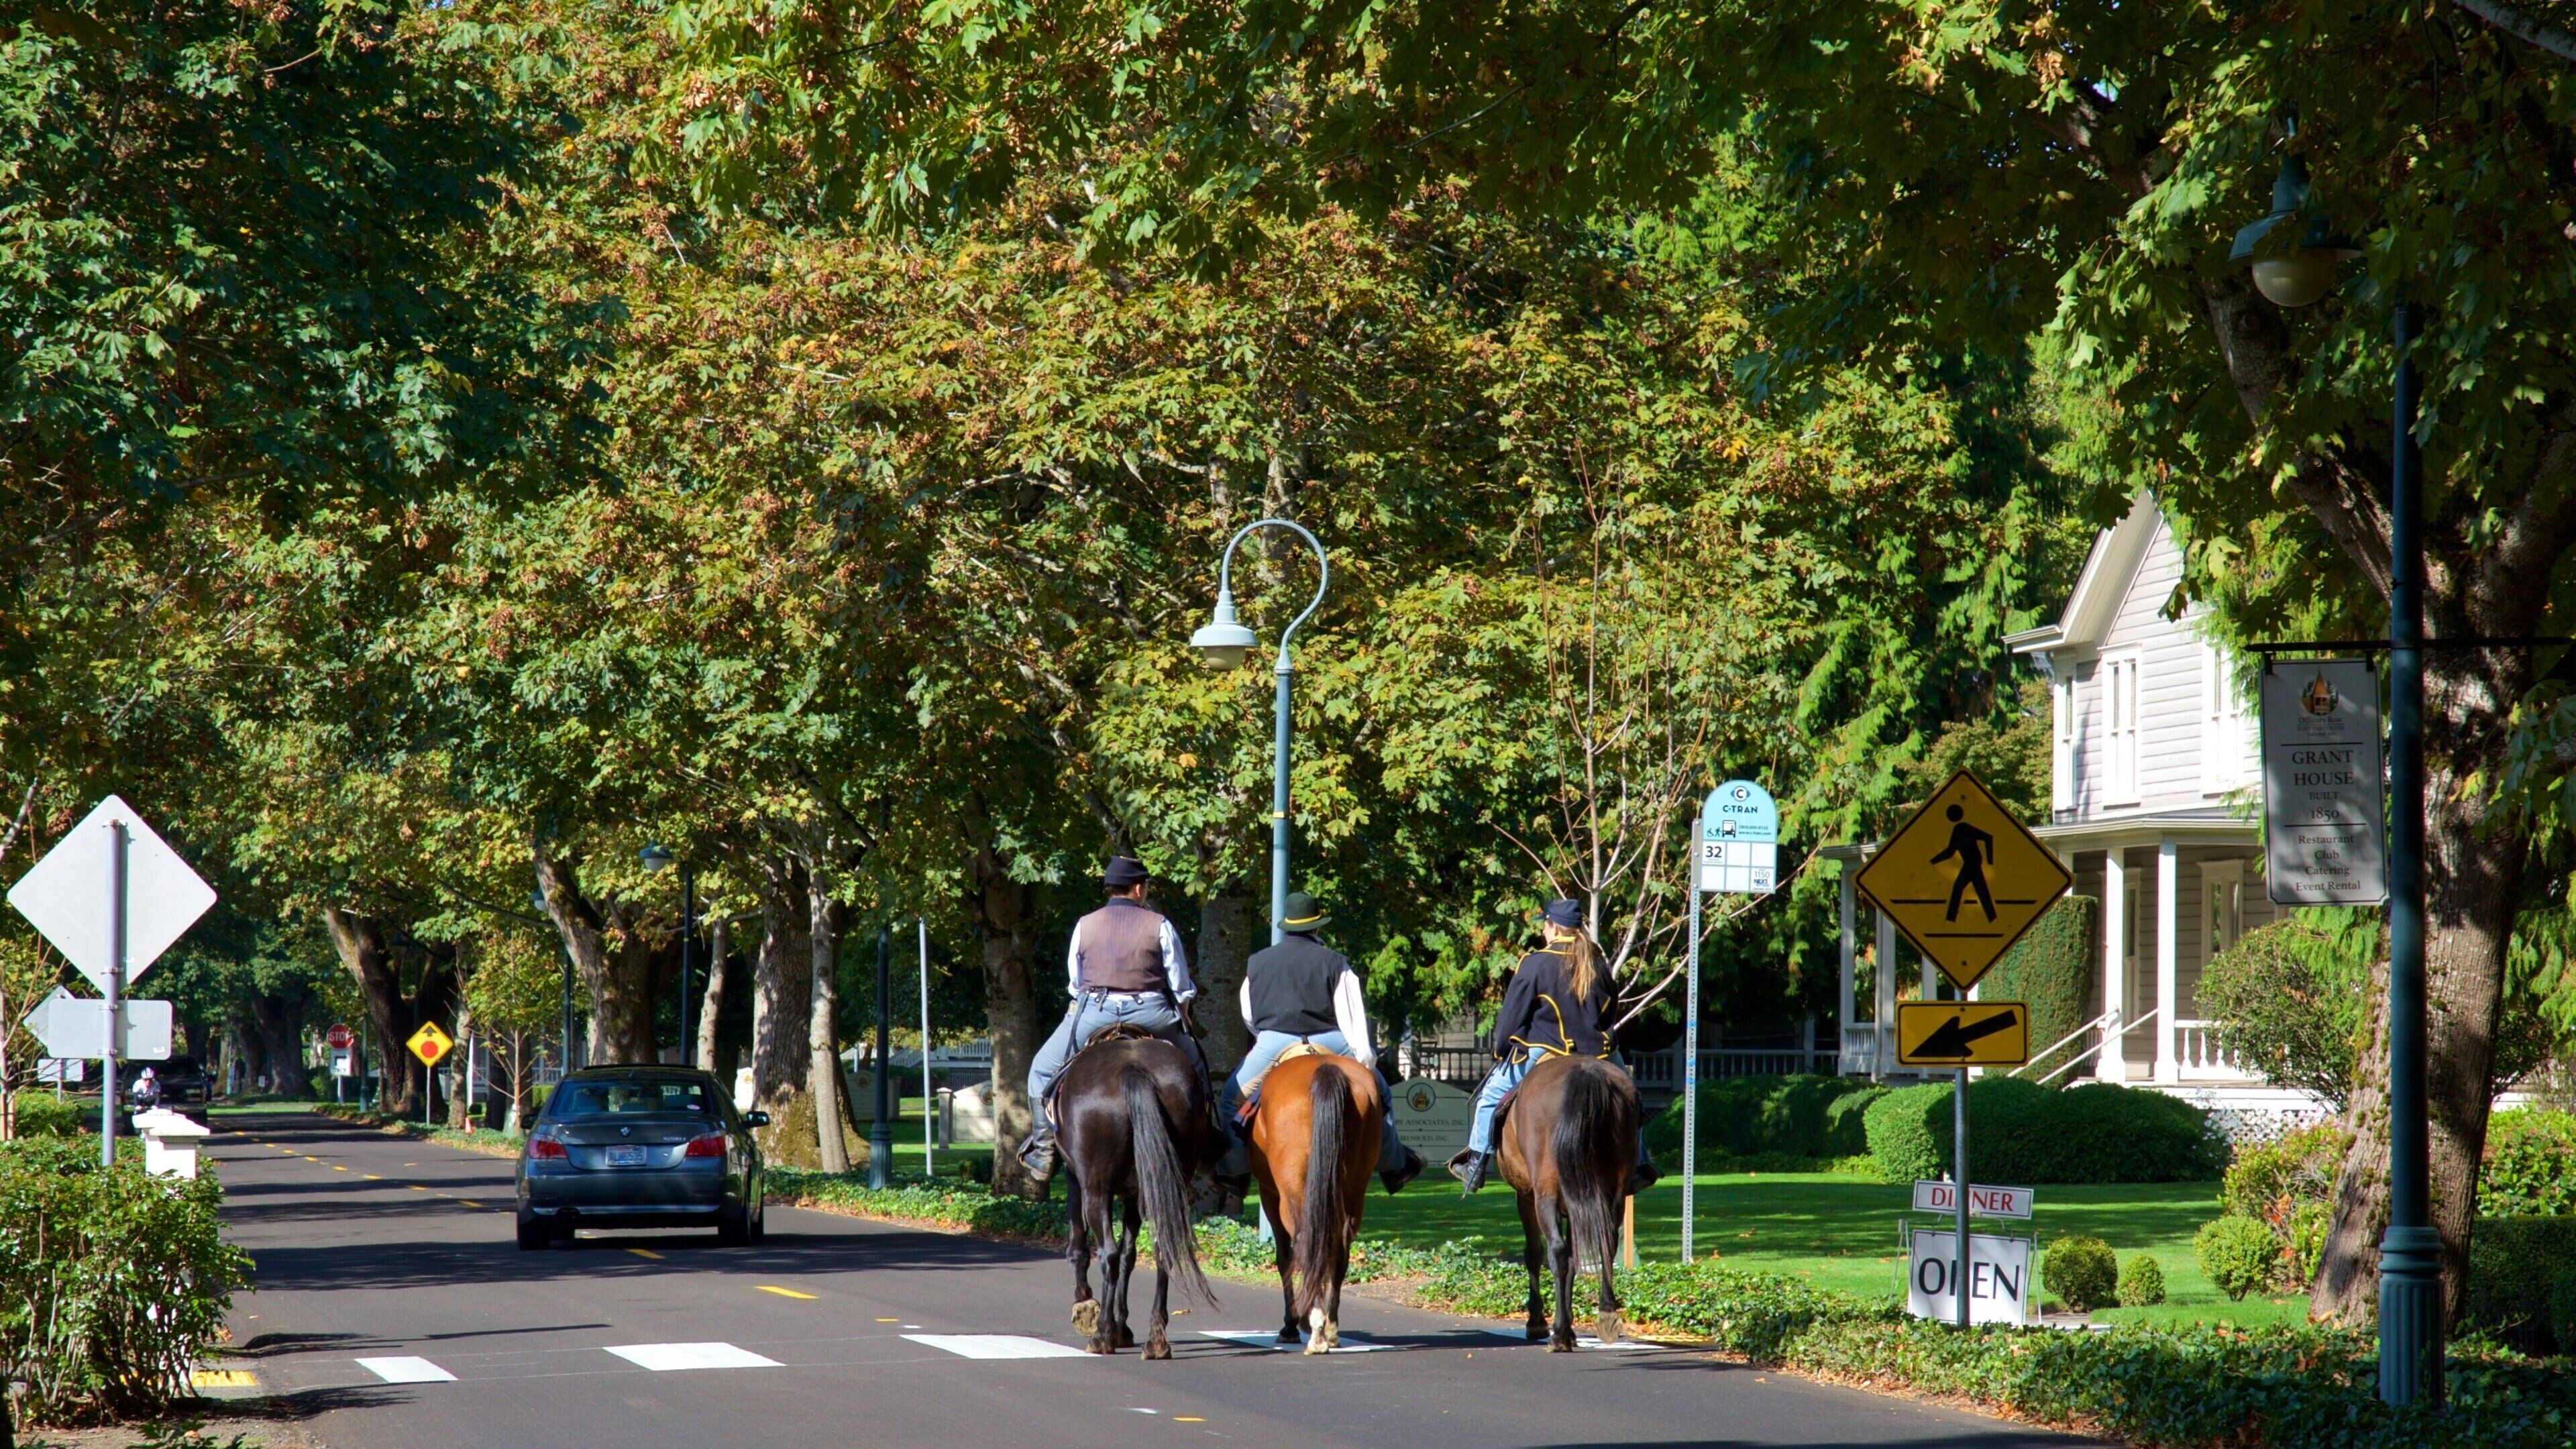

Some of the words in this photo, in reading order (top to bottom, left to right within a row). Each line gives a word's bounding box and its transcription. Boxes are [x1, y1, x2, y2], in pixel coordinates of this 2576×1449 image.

[2292, 750, 2354, 764] GRANT
[2293, 772, 2354, 786] HOUSE
[2310, 792, 2339, 800] BUILT
[1723, 805, 1758, 813] C-TRAN
[2310, 806, 2340, 822] 1850
[2298, 835, 2354, 844] Restaurant
[1705, 846, 1722, 858] 32
[2314, 850, 2339, 859] Club
[2305, 866, 2351, 877] Catering
[2296, 881, 2324, 891] Event
[2328, 880, 2361, 890] Rental
[1931, 1187, 2014, 1212] DINER
